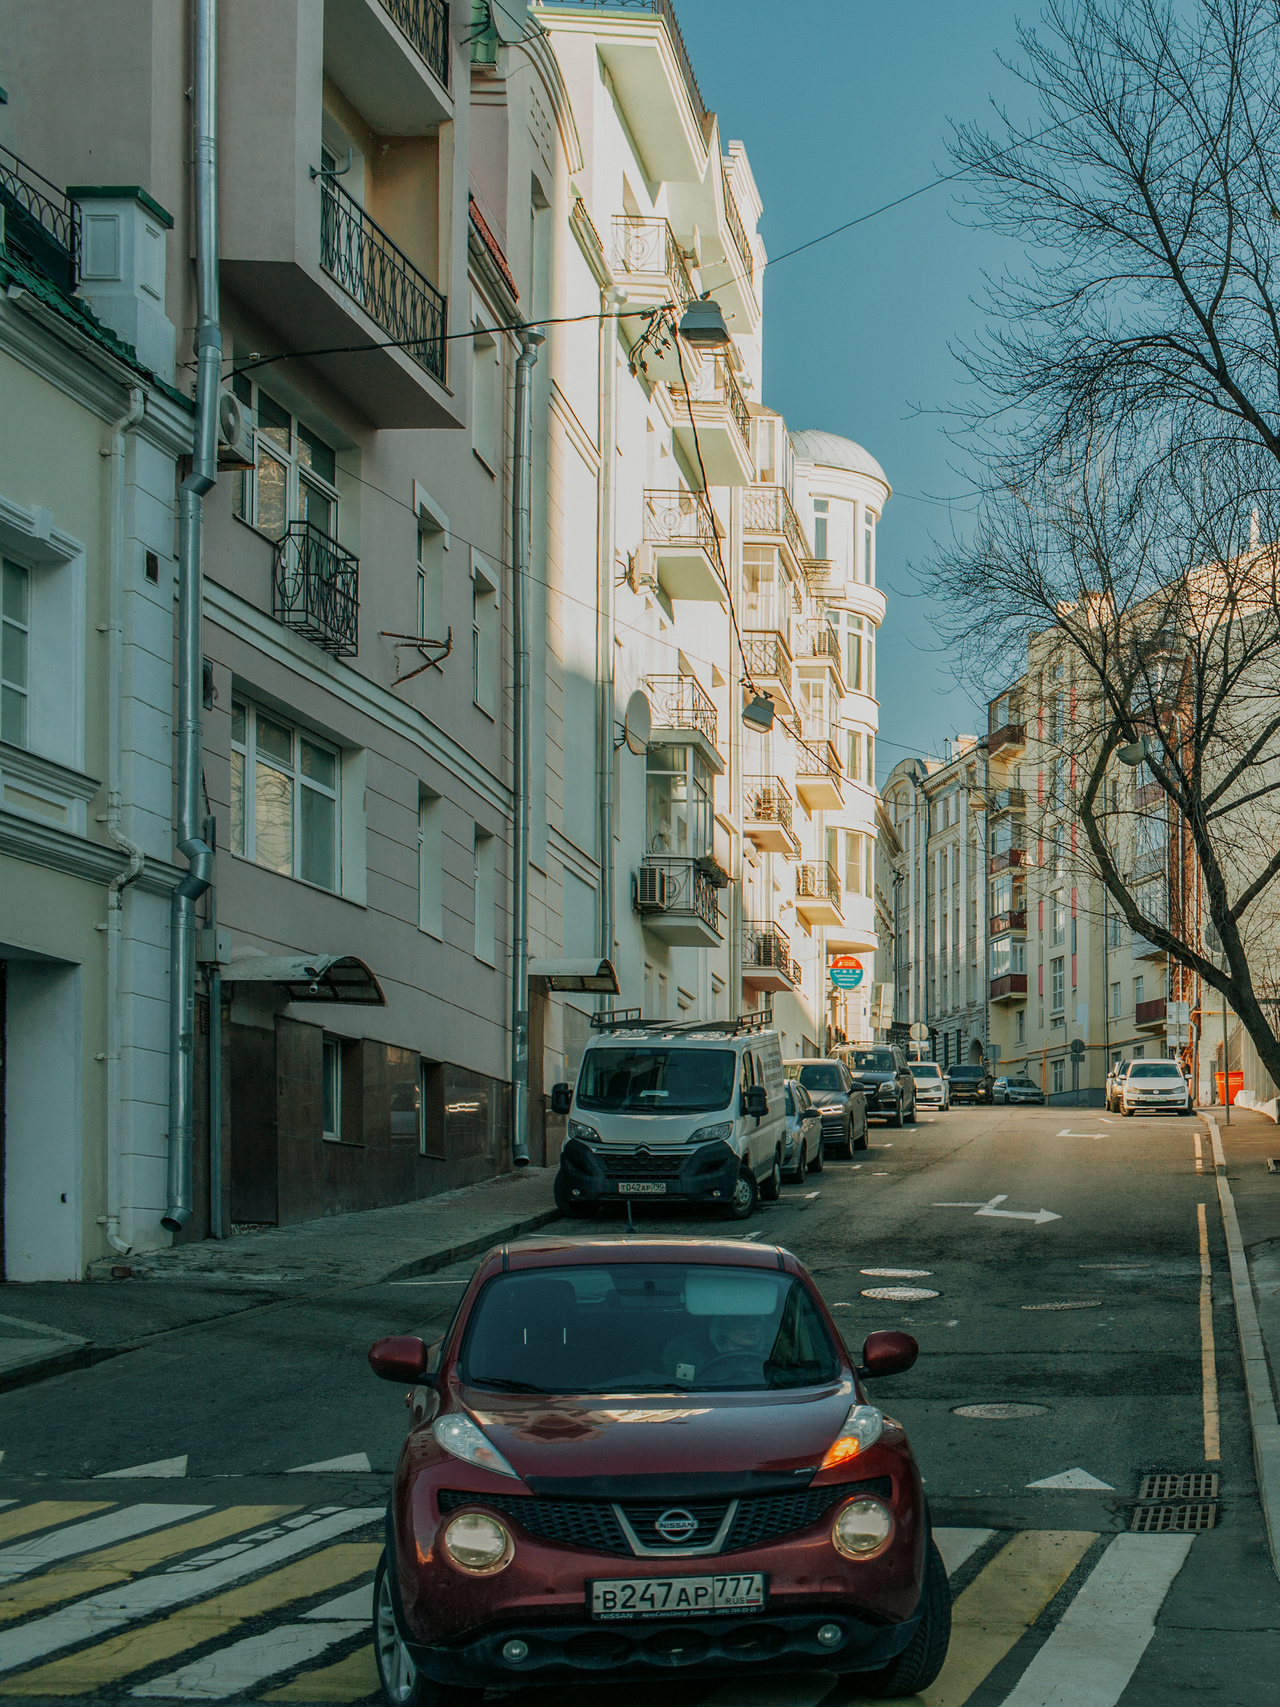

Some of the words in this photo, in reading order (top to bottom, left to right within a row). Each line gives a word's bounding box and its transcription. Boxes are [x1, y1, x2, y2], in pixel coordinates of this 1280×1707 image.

[602, 1581, 709, 1610] В247АР
[715, 1576, 755, 1598] 777
[725, 1596, 745, 1605] RUS
